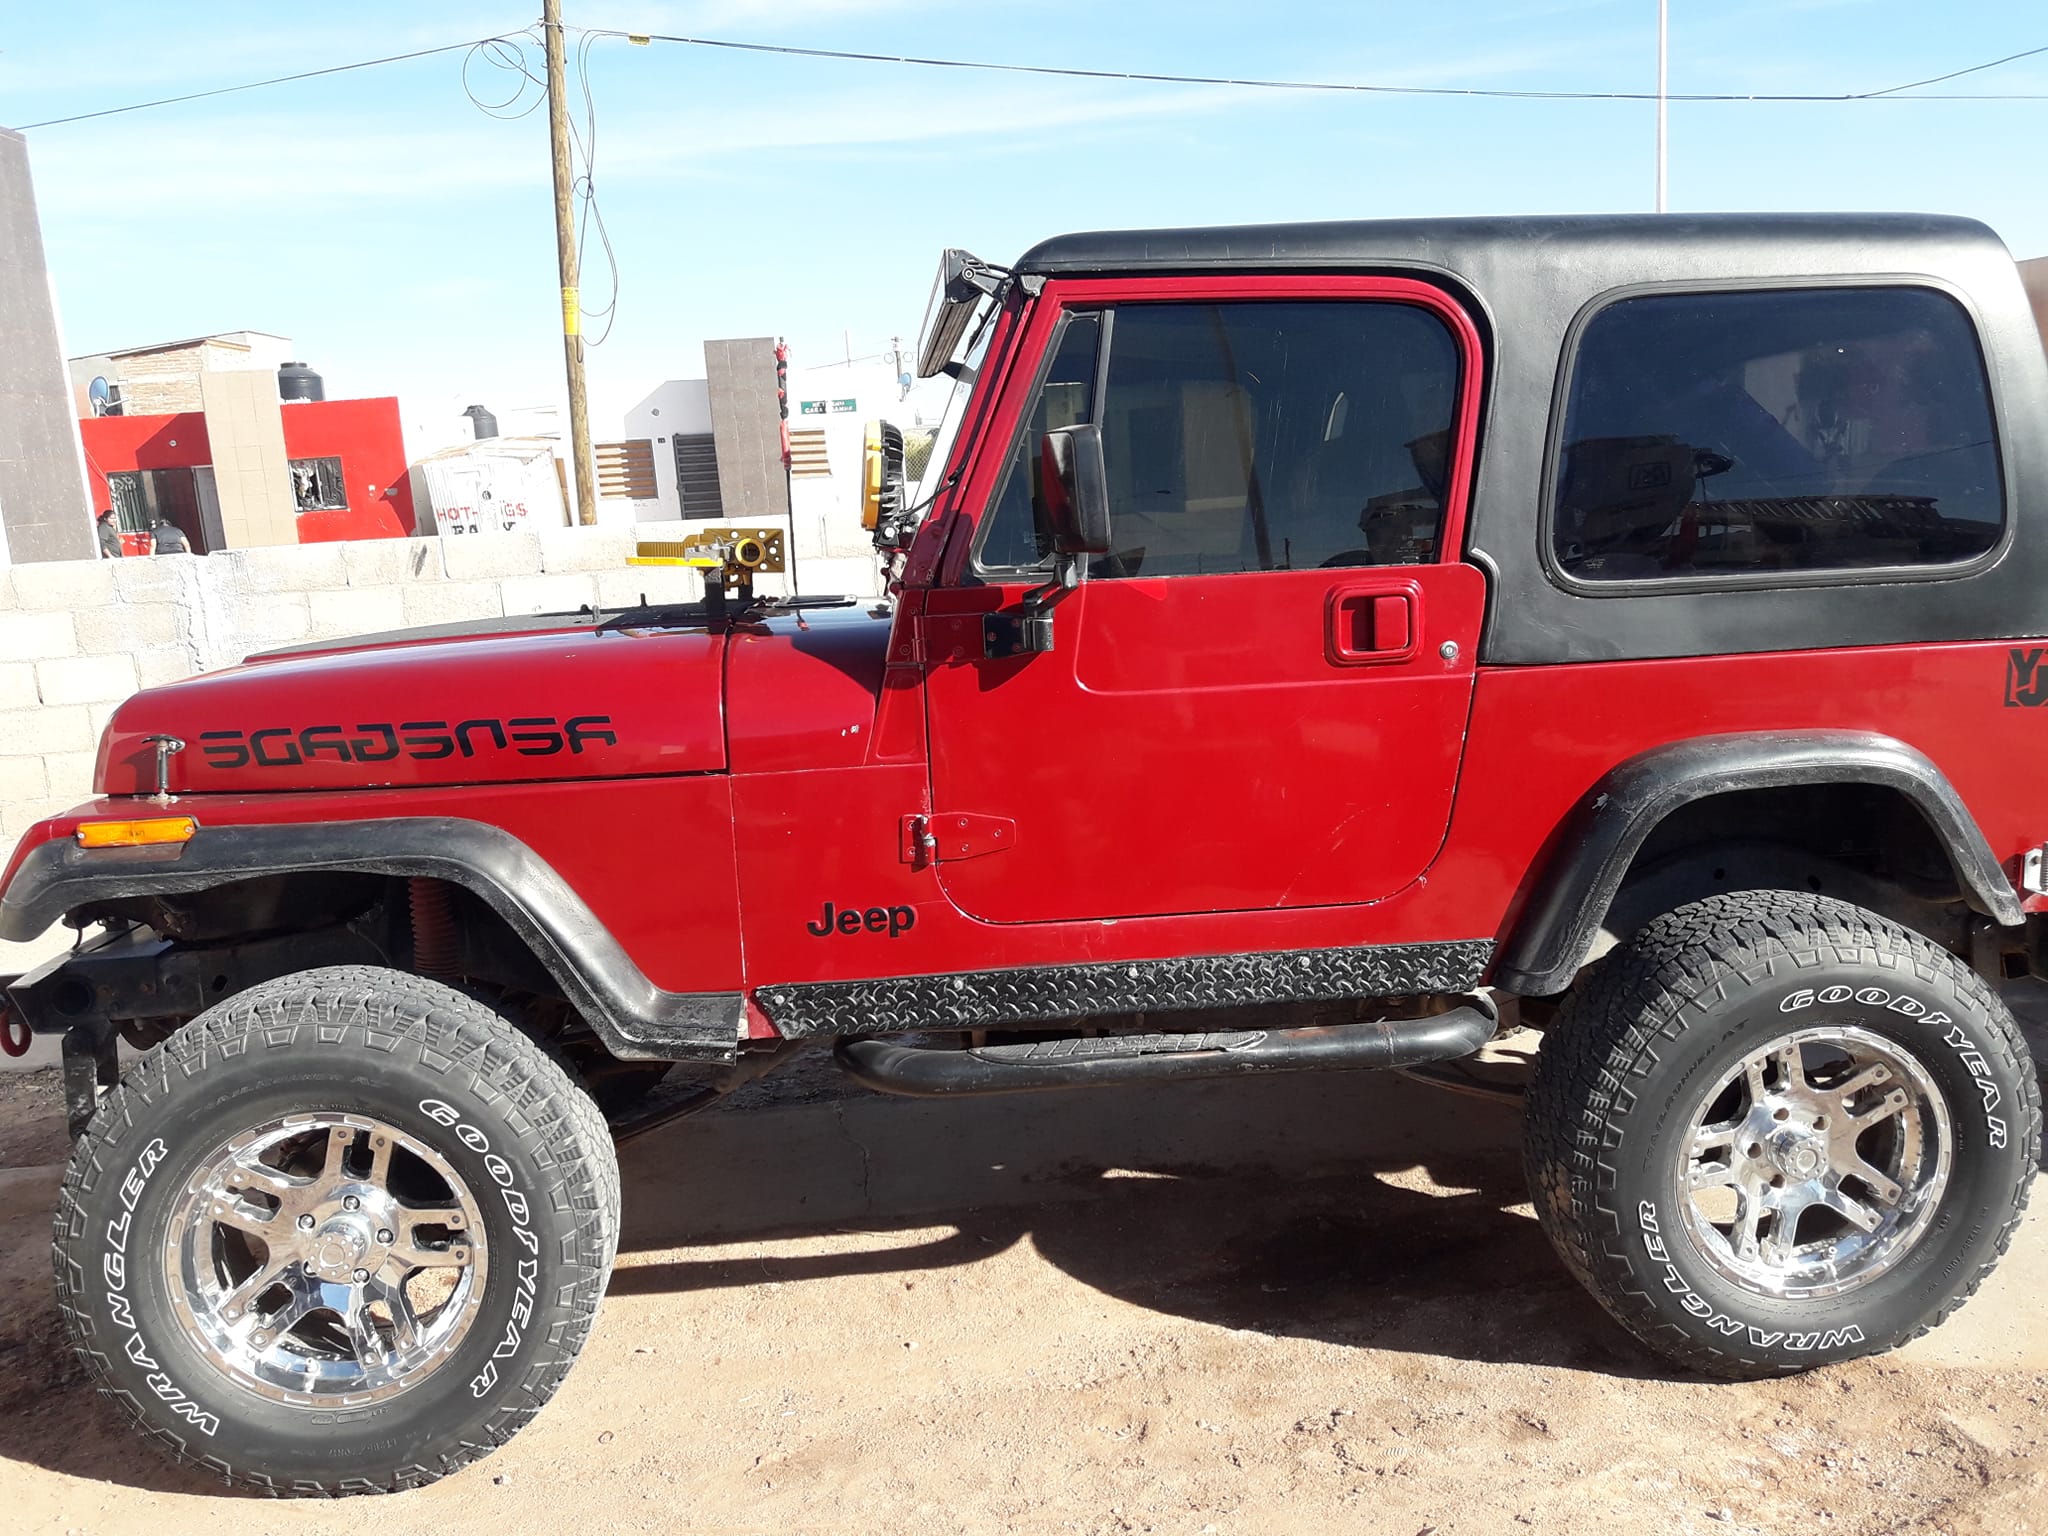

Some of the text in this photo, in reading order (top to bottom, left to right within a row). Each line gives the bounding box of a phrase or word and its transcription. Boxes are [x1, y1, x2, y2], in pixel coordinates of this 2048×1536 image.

[436, 503, 528, 523] HOT-GS
[807, 901, 917, 939] Jeep
[1778, 985, 2007, 1149] GOODYEAR
[103, 1137, 220, 1436] WRANGLER
[417, 1098, 541, 1399] GOODYEAR
[1637, 1200, 1865, 1351] WRANGLER
